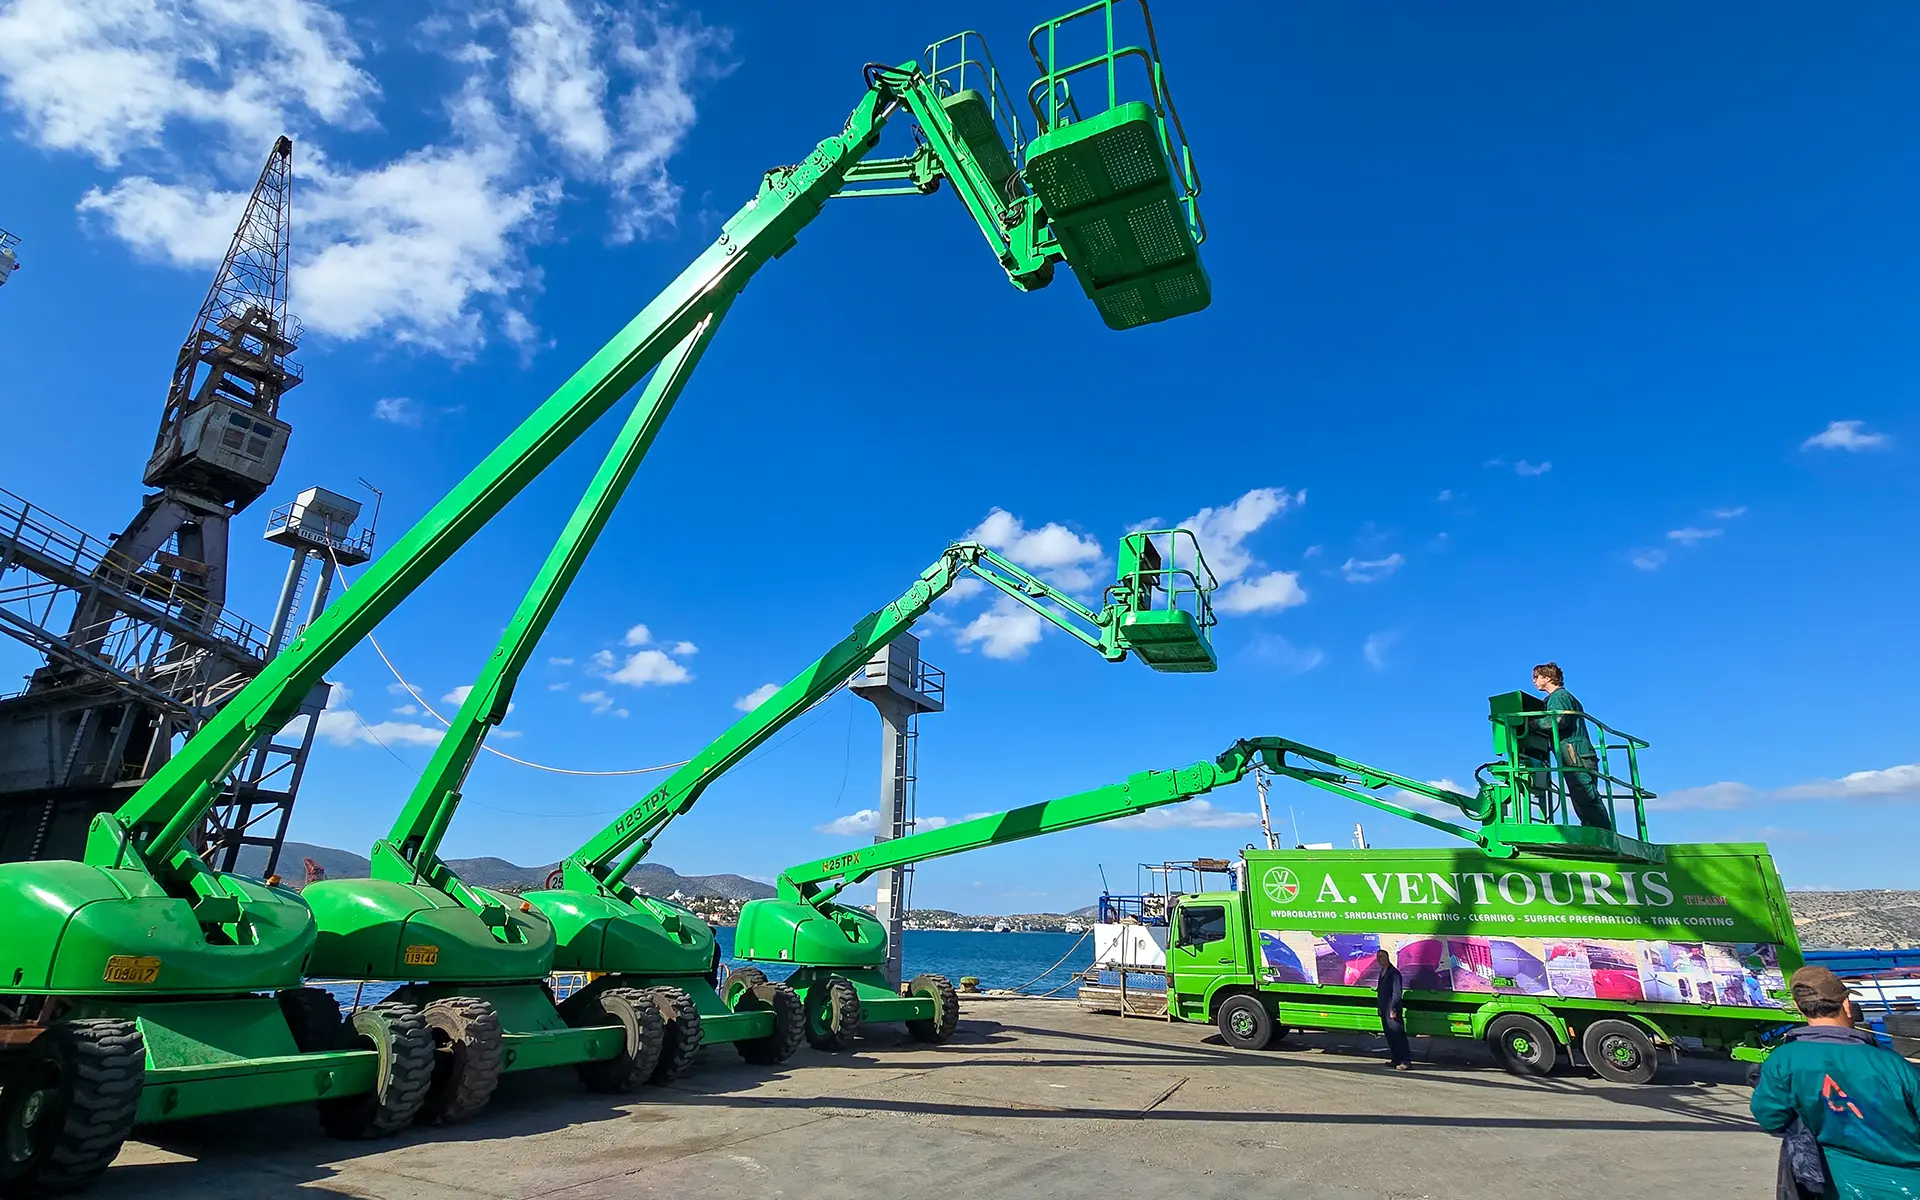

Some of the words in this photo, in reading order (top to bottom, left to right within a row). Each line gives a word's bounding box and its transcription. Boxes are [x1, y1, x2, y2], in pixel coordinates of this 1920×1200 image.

[300, 530, 344, 549] ΠΕΙΡΑΑΣ
[552, 876, 564, 890] 25
[1315, 873, 1358, 904] A.
[1361, 871, 1674, 906] VENTOURIS
[1683, 895, 1728, 906] TEAM
[1270, 910, 1337, 919] HYDROBLASTING
[1344, 911, 1409, 921] SANDBLASTING
[1417, 913, 1460, 922] PAINTING
[1468, 914, 1516, 923] CLEANING
[1524, 914, 1567, 924] SURFACE
[1569, 915, 1642, 926] PREPARATION
[1651, 916, 1680, 926] TANK
[1683, 917, 1735, 927] COATING
